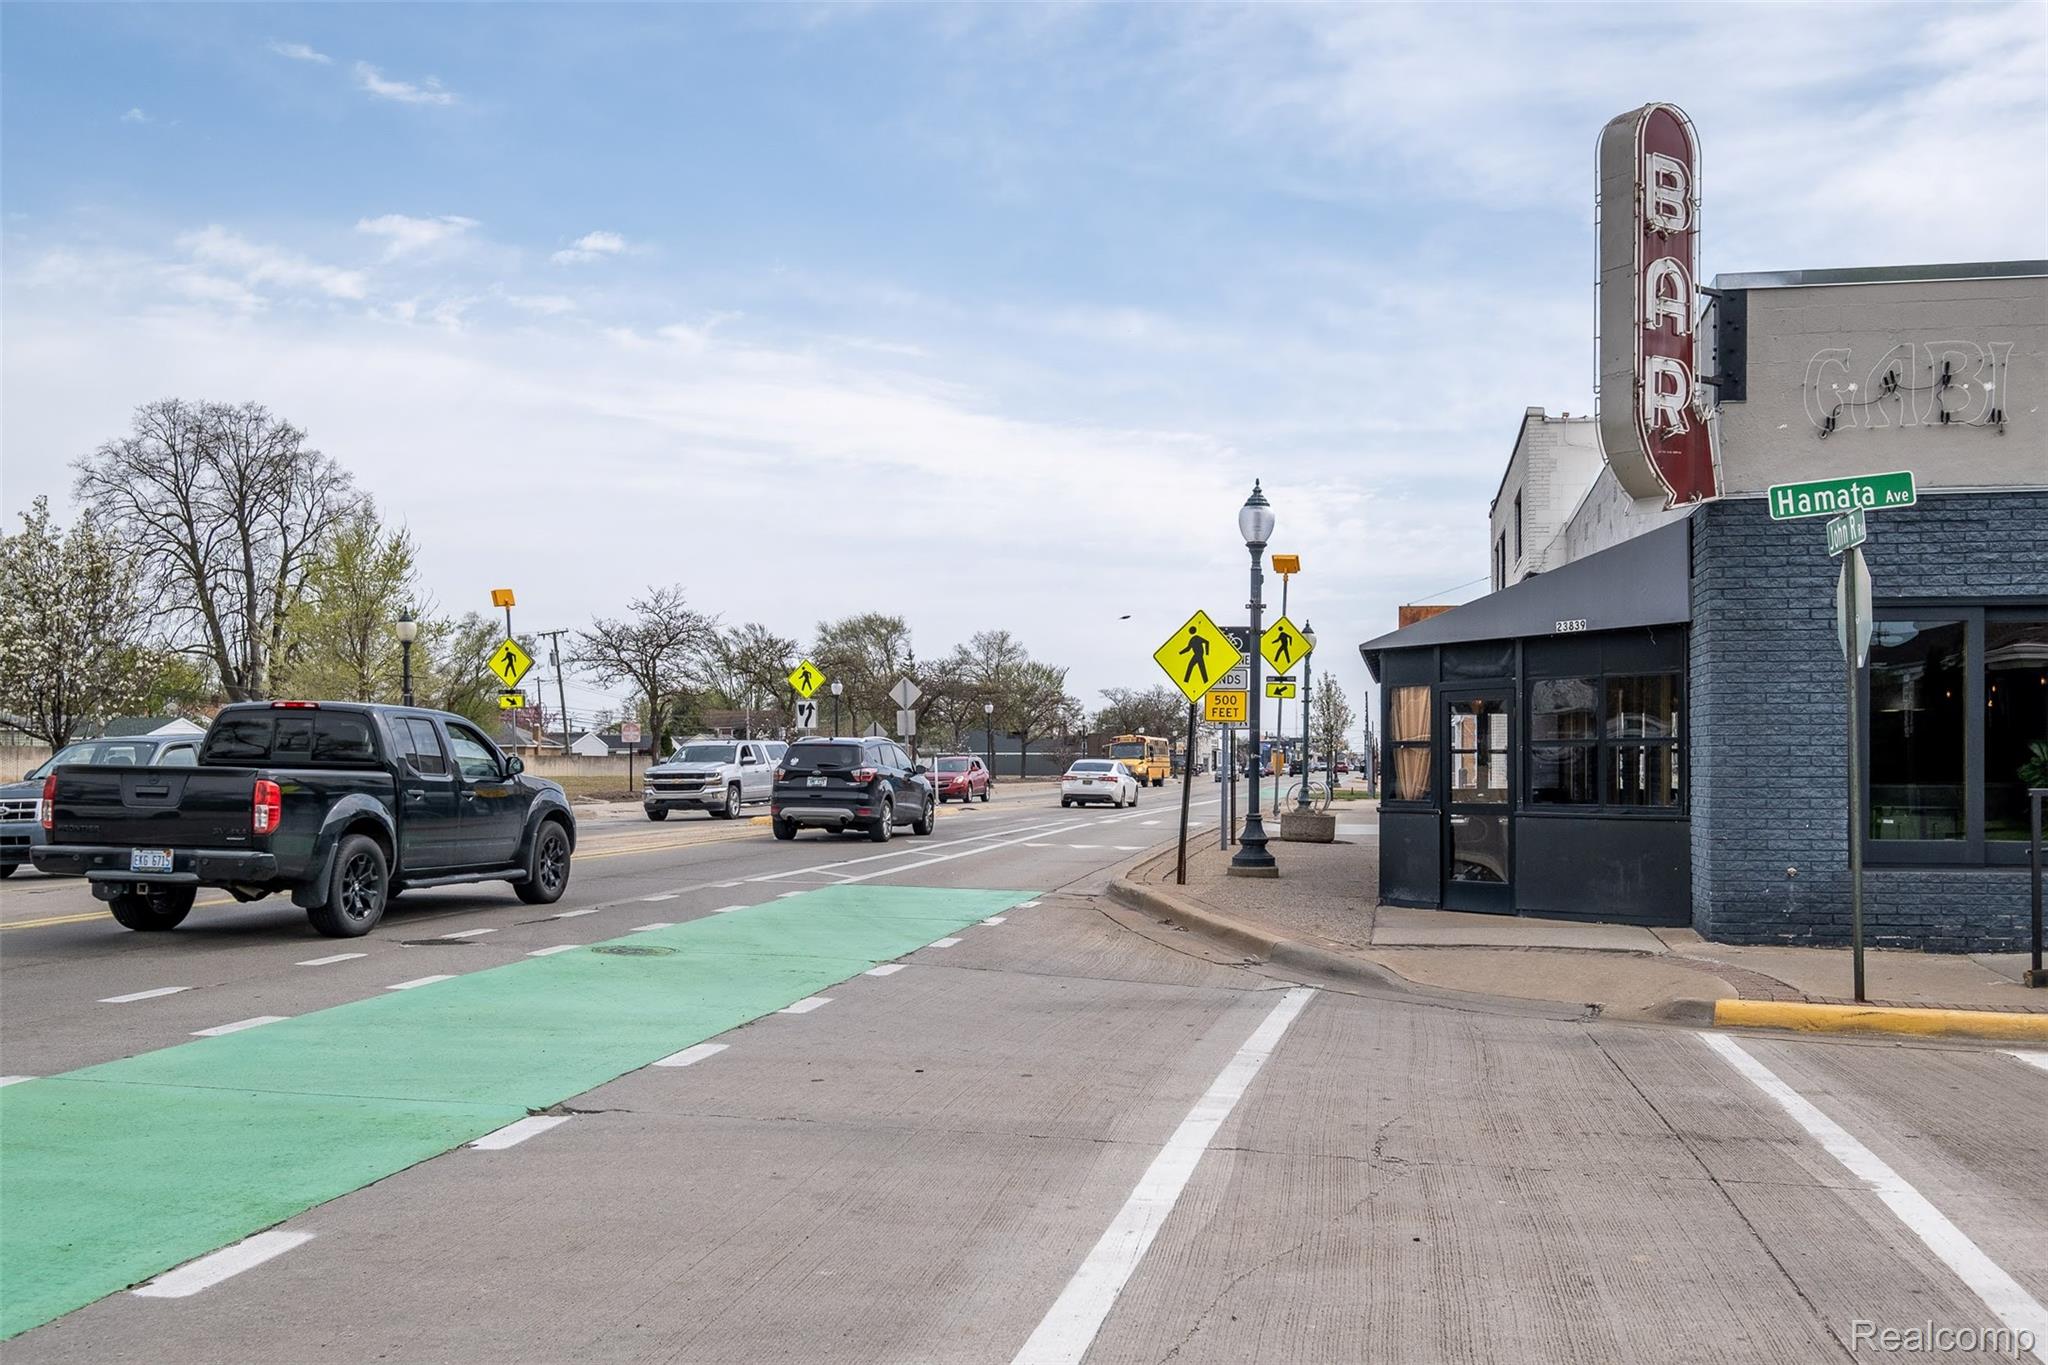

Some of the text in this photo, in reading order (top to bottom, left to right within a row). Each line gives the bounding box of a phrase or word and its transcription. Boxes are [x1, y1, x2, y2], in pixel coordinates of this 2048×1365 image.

[1644, 151, 1693, 437] BAR
[1803, 340, 2014, 430] GABI
[1776, 482, 1909, 516] Hamata Ave
[1830, 522, 1849, 551] John
[1849, 515, 1857, 541] R
[1556, 620, 1586, 632] 23839
[1219, 674, 1241, 685] NDS
[1214, 695, 1237, 705] 500
[1211, 707, 1239, 718] FEET
[151, 855, 170, 867] 6715
